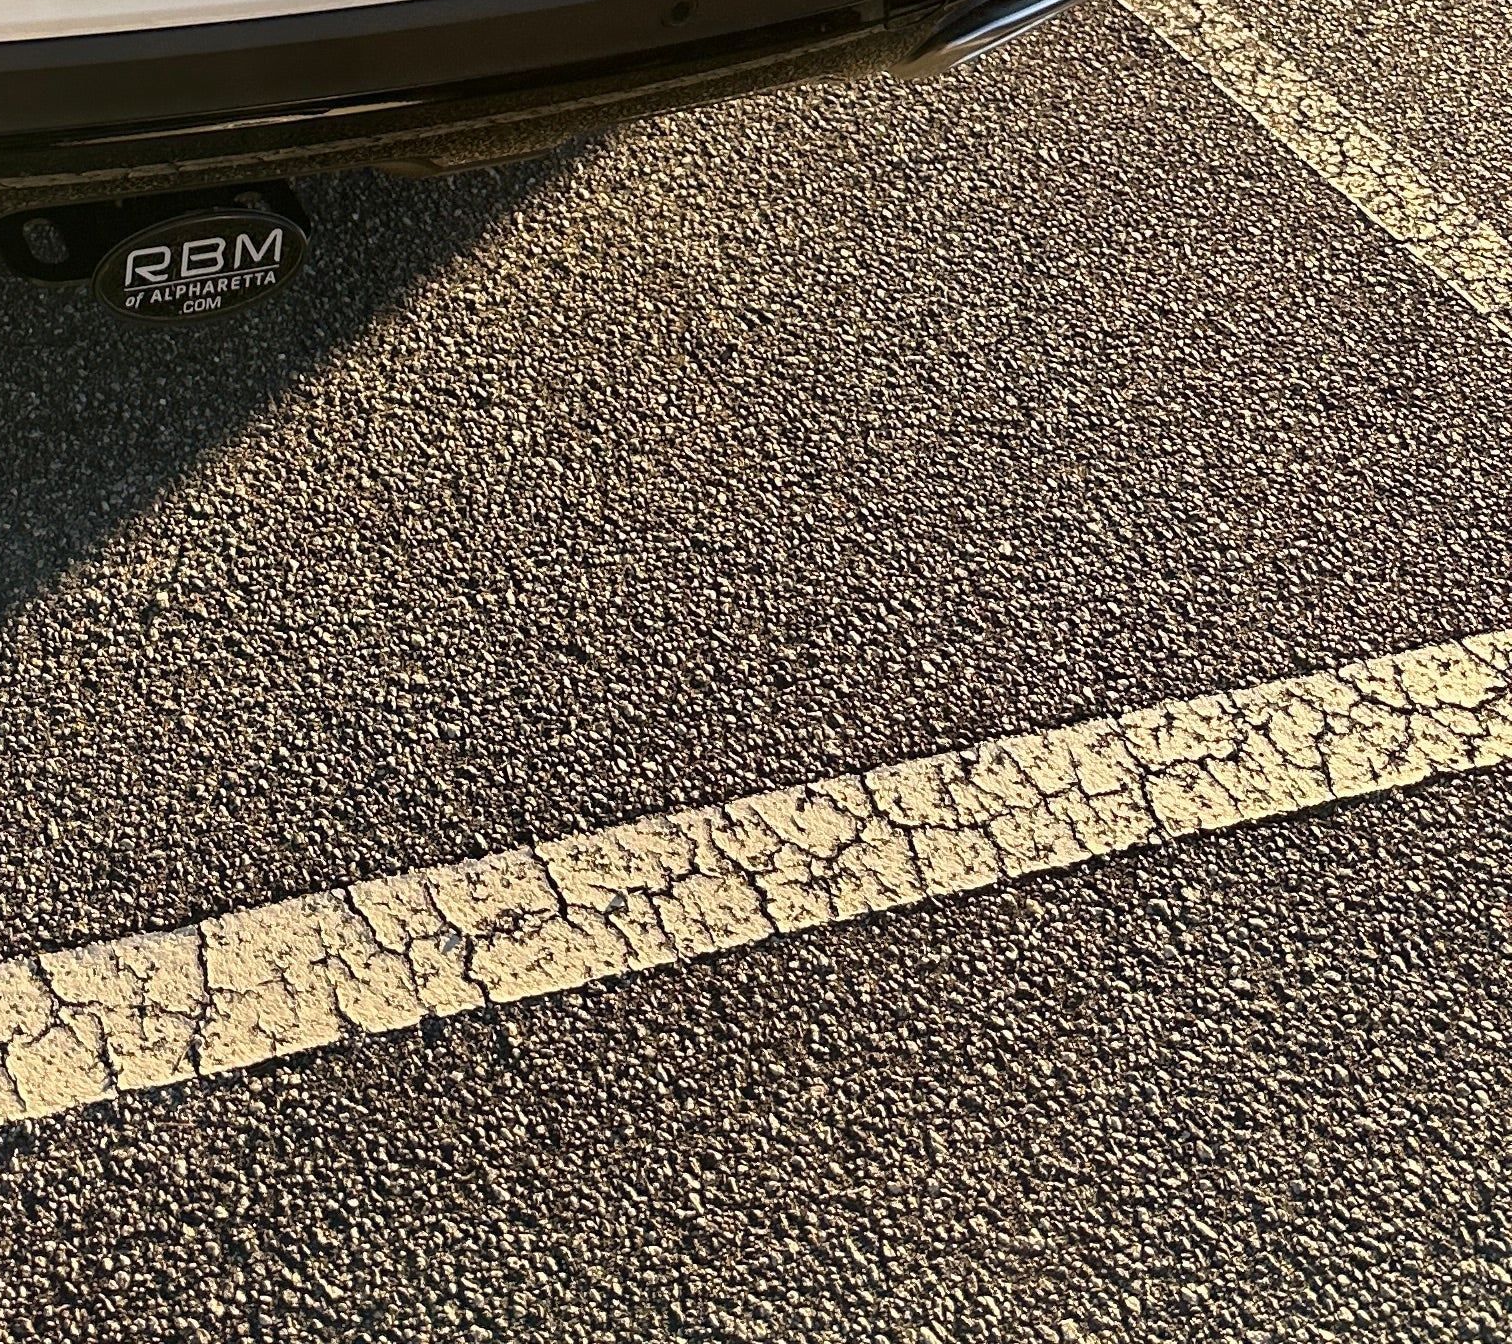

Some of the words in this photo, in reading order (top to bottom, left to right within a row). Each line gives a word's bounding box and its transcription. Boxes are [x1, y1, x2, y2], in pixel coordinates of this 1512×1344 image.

[124, 228, 283, 287] RBM
[125, 292, 145, 309] of
[150, 271, 276, 304] ALPHARETTA
[178, 296, 222, 315] .COM
